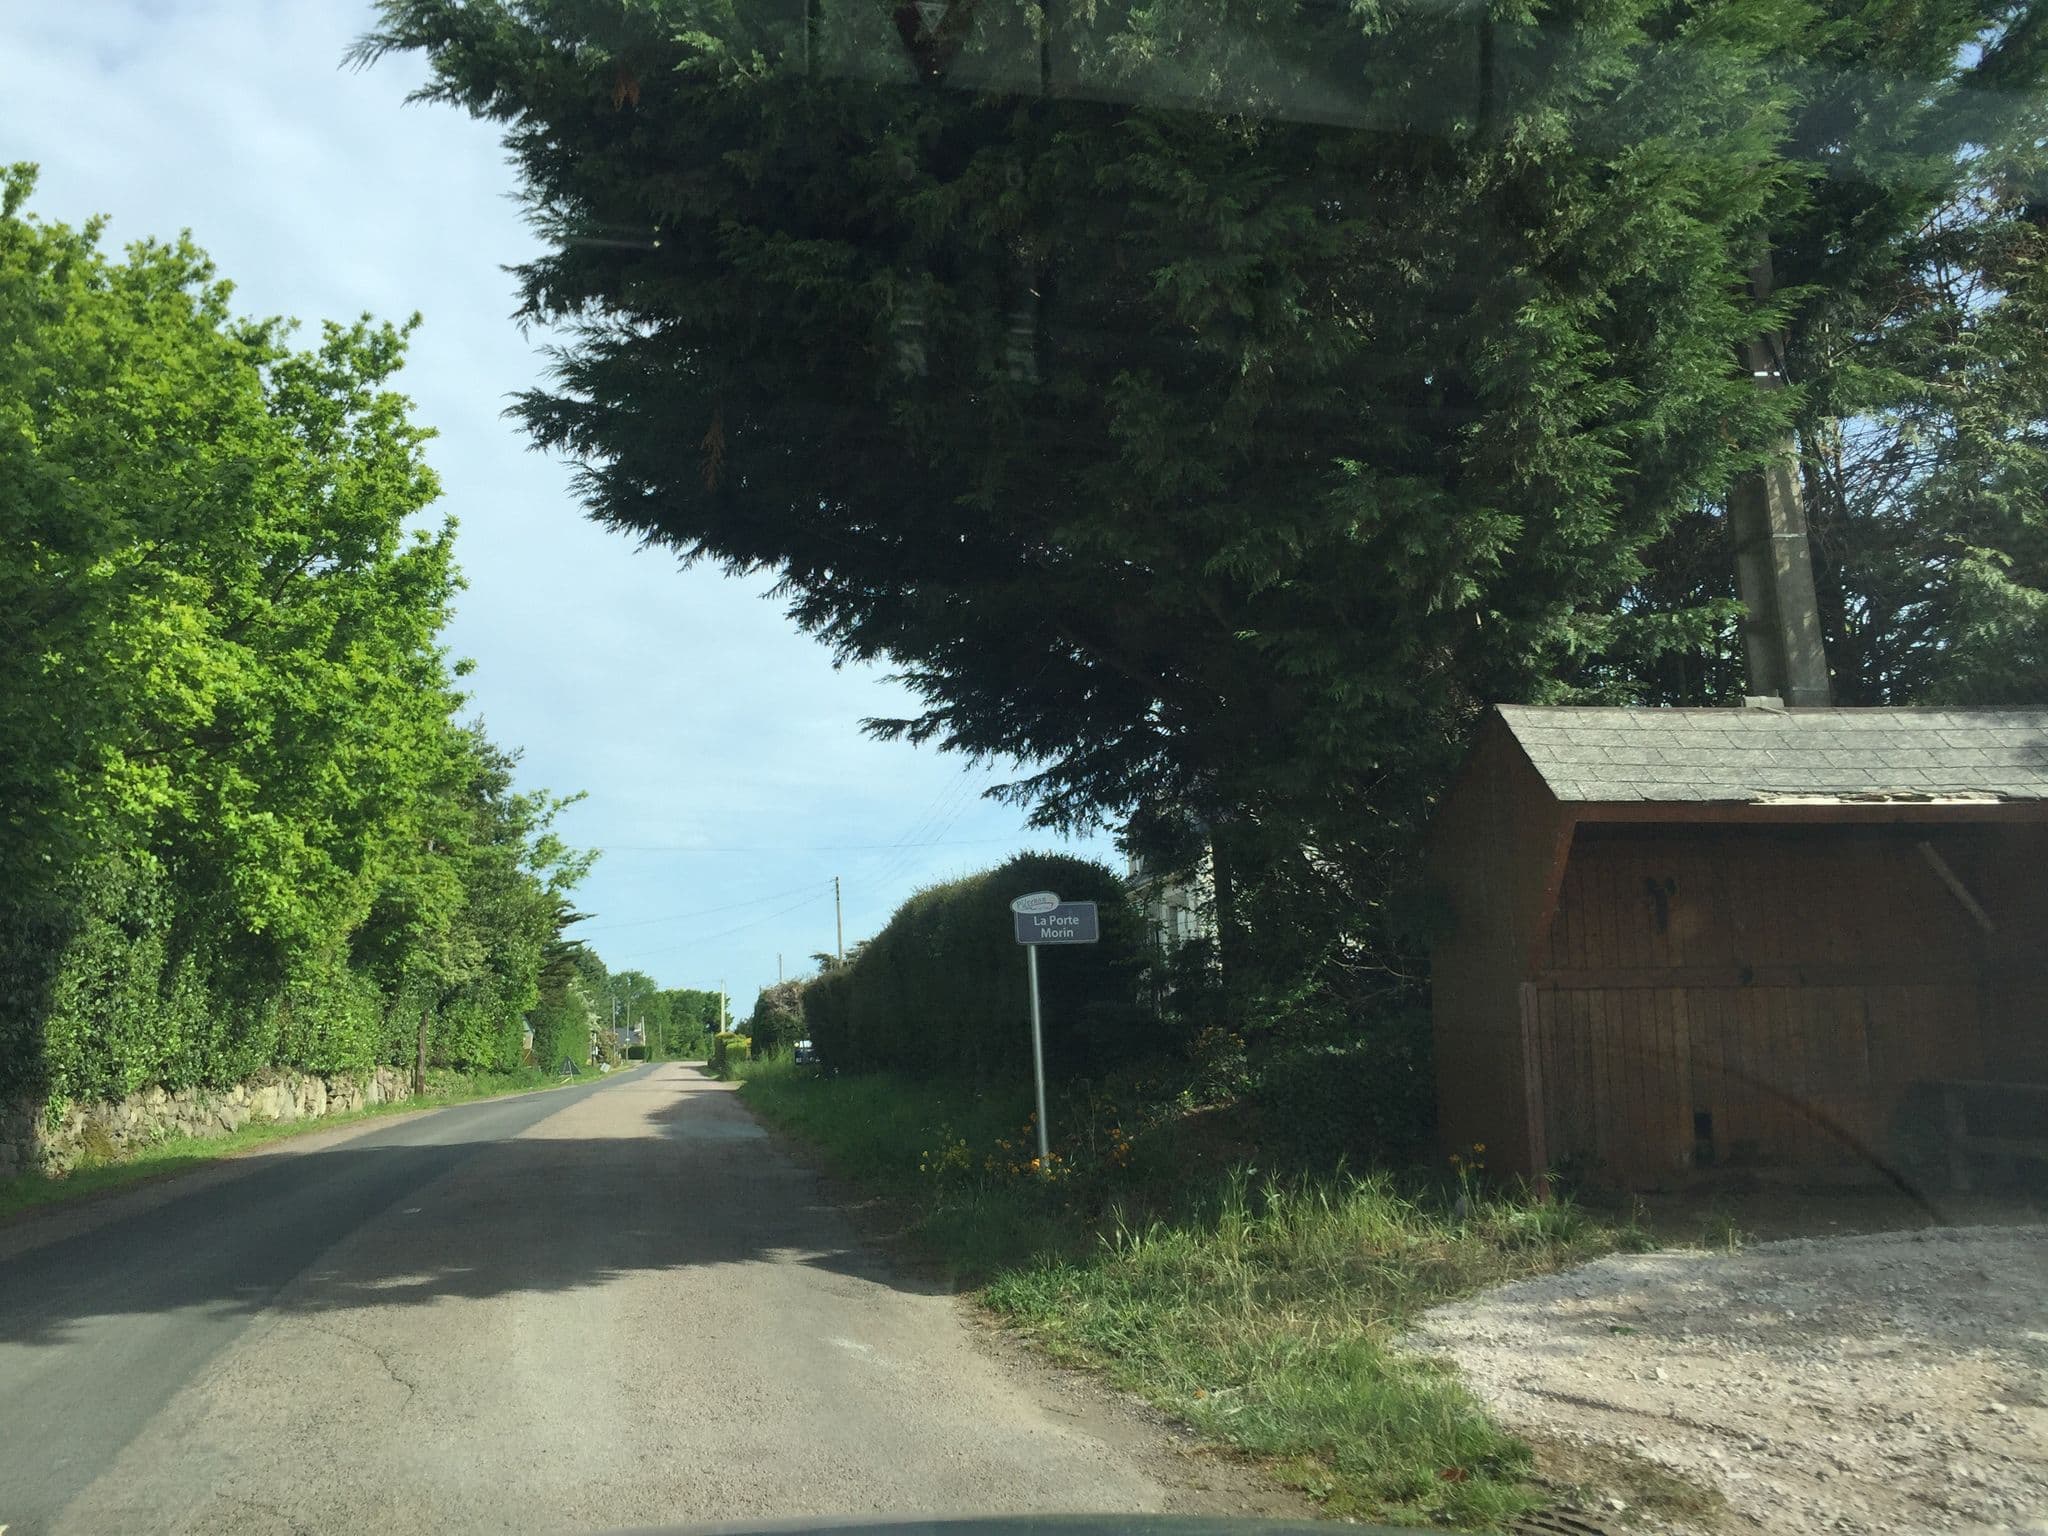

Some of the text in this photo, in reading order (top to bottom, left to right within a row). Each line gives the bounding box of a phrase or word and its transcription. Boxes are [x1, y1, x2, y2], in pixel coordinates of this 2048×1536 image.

[1033, 915, 1080, 926] La Porte
[1040, 927, 1074, 938] Morin
